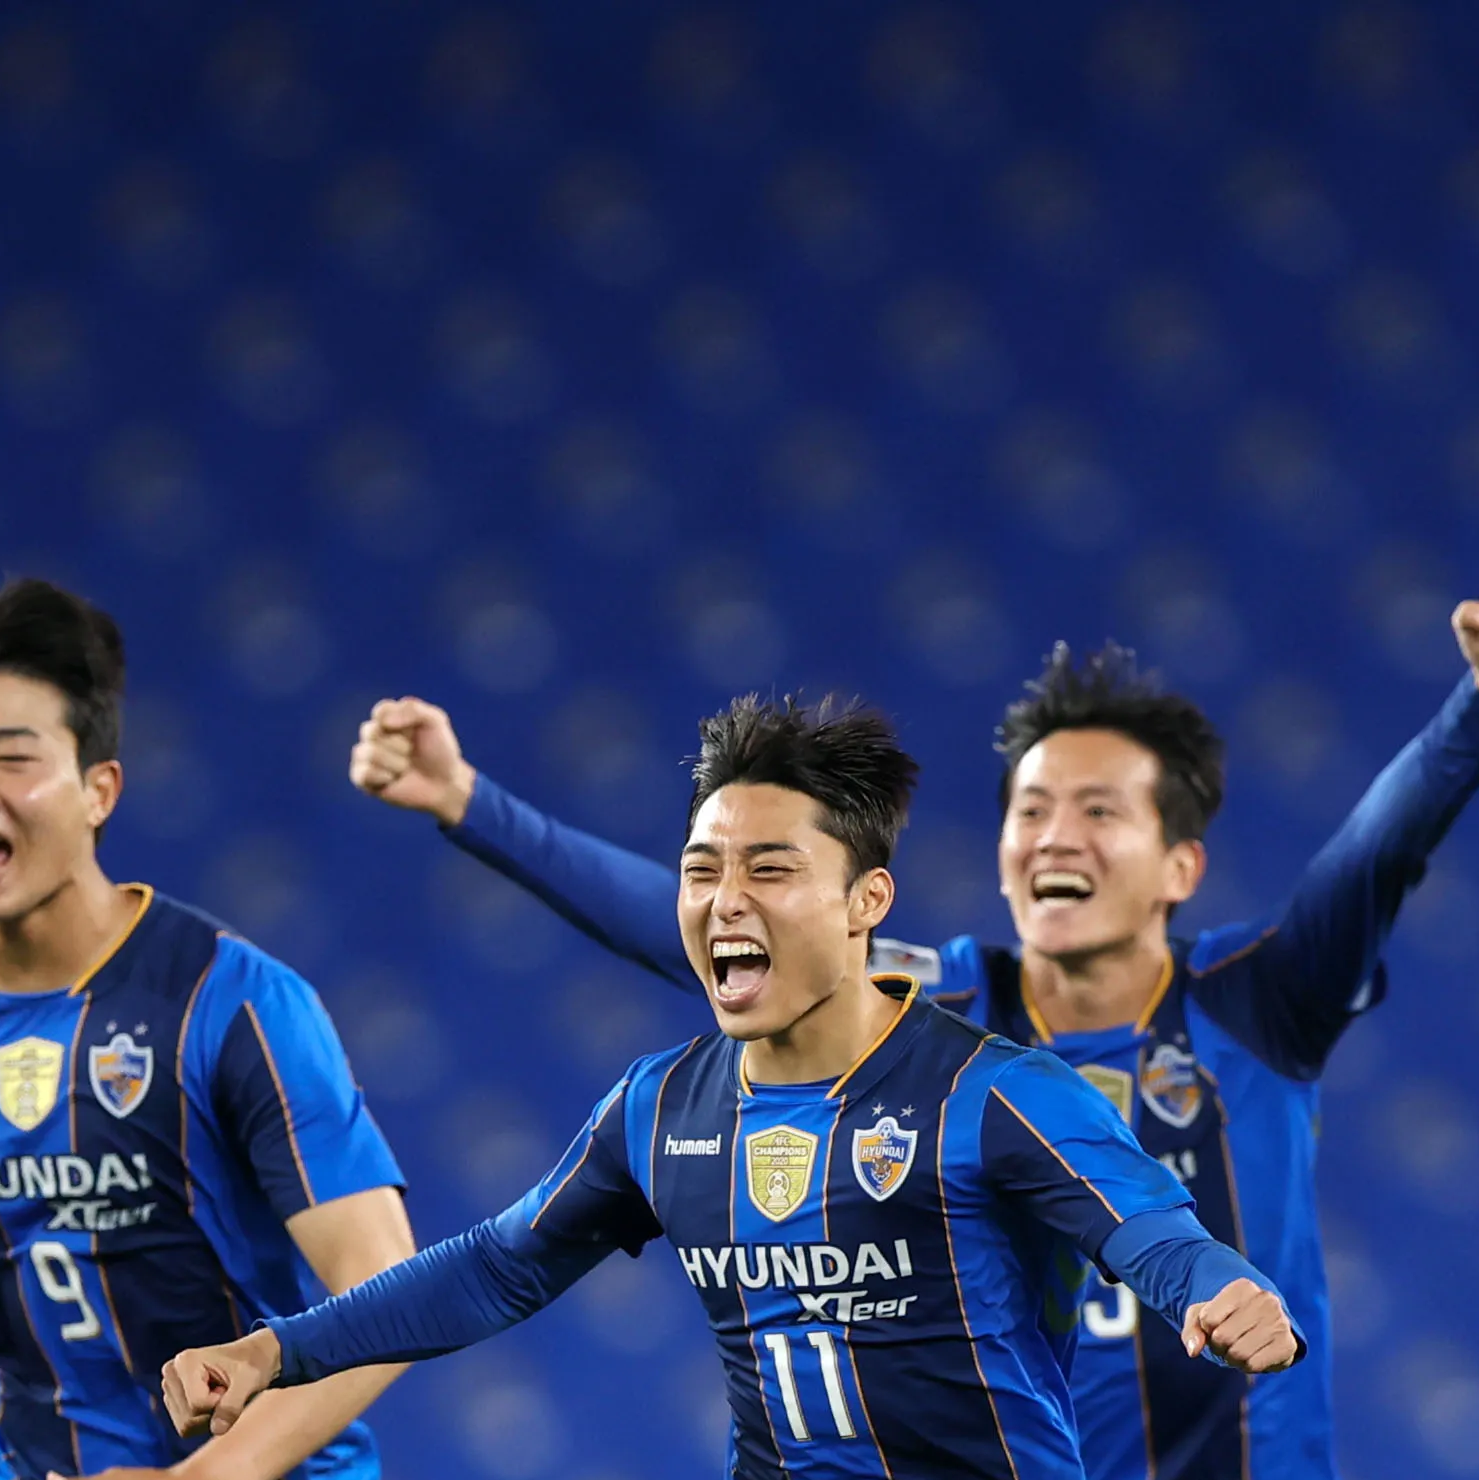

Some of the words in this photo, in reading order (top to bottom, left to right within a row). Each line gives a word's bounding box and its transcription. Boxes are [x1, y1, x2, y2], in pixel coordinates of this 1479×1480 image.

[664, 1133, 722, 1156] hummel
[753, 1146, 808, 1156] CHAMPIONS
[773, 1135, 791, 1145] AFC
[771, 1156, 789, 1166] 2020
[861, 1145, 905, 1160] HYUNDAI
[678, 1238, 913, 1289] HYUNDAI
[30, 1241, 101, 1342] 9
[797, 1290, 919, 1323] XTeer
[764, 1331, 857, 1442] 11
